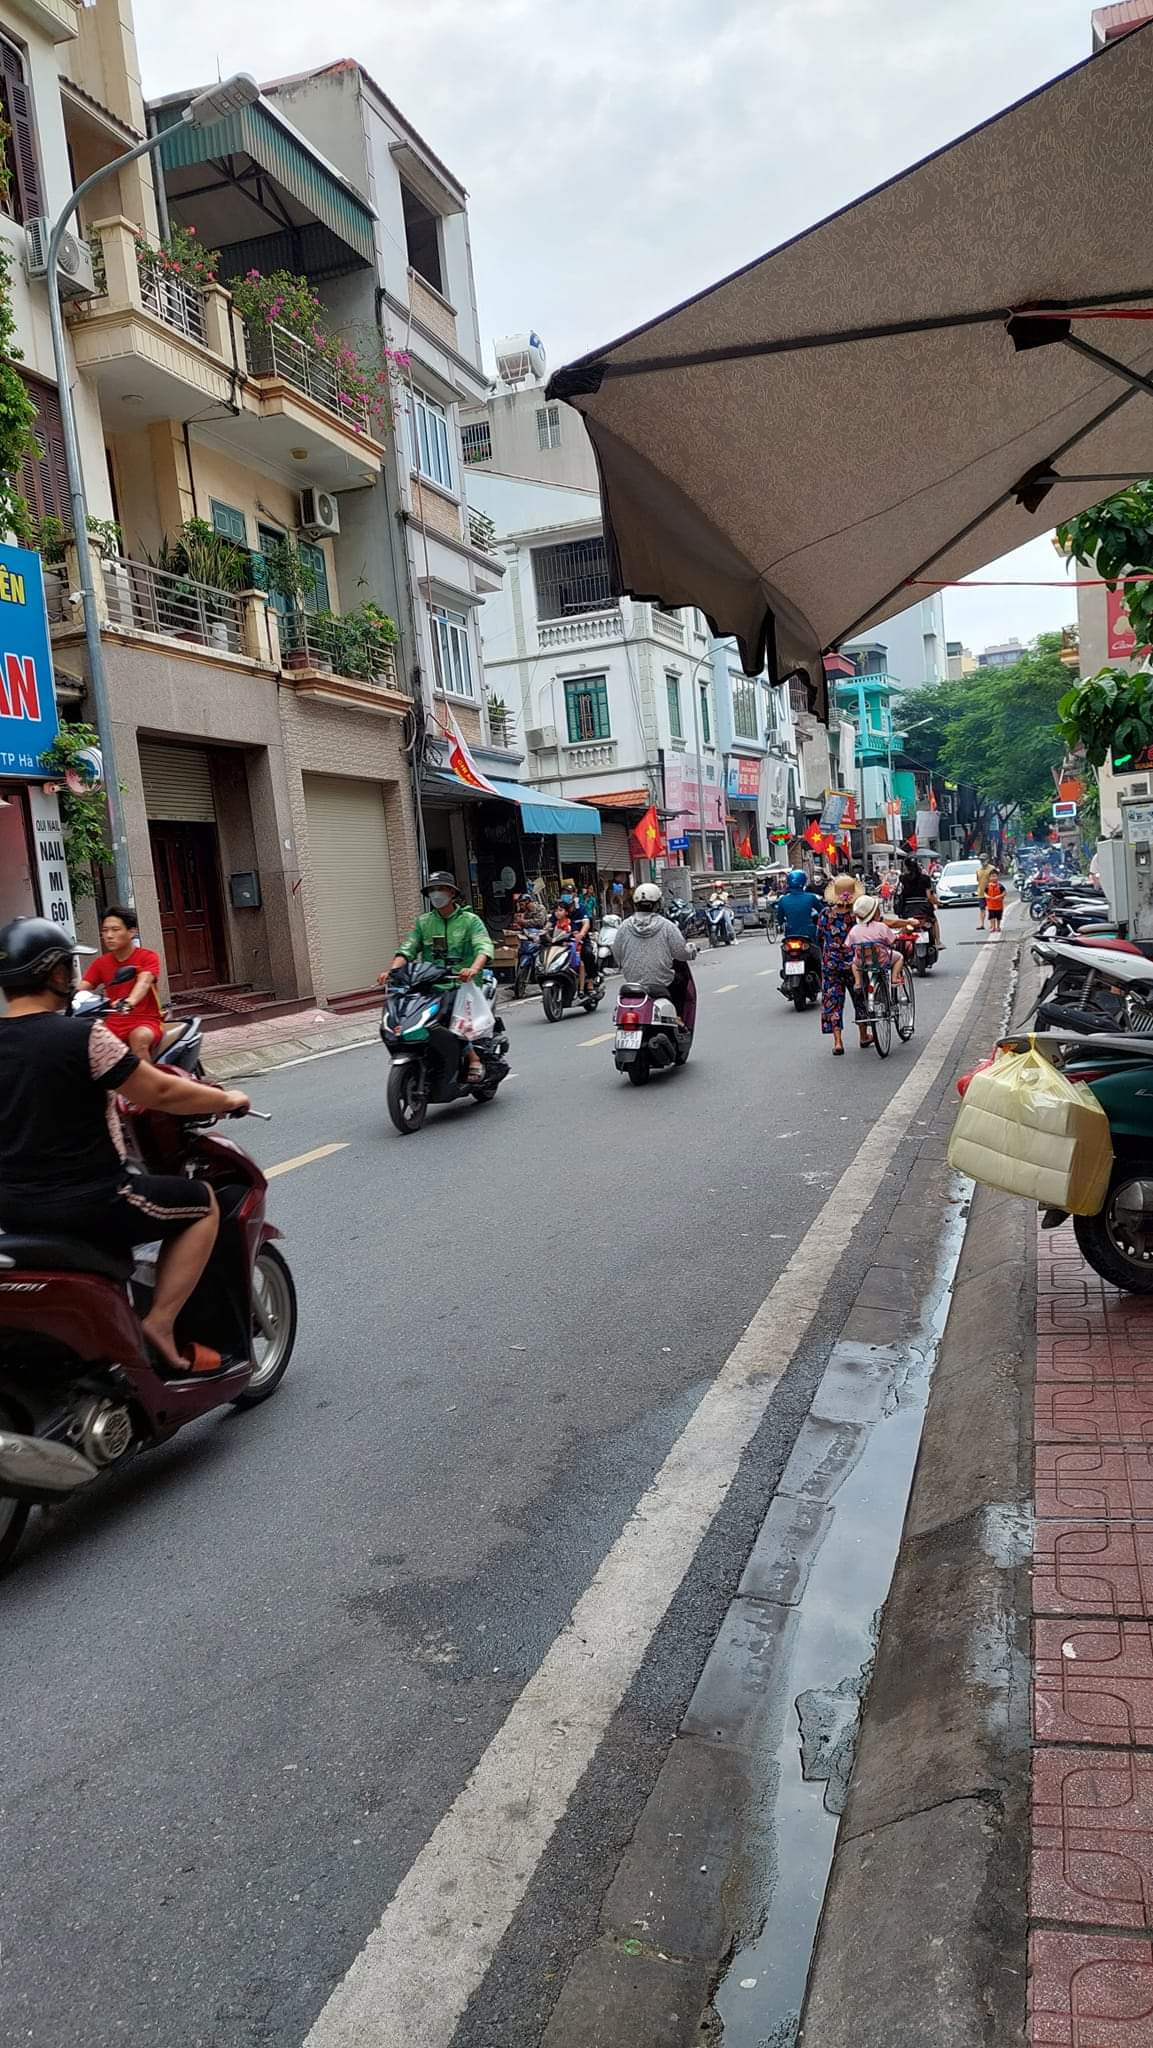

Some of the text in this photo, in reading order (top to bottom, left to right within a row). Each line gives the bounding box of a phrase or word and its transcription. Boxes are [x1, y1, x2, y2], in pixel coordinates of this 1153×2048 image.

[0, 751, 15, 767] TP
[18, 753, 34, 768] Hà
[40, 840, 65, 861] NAIL
[49, 871, 64, 892] MI
[50, 897, 69, 926] GỘI
